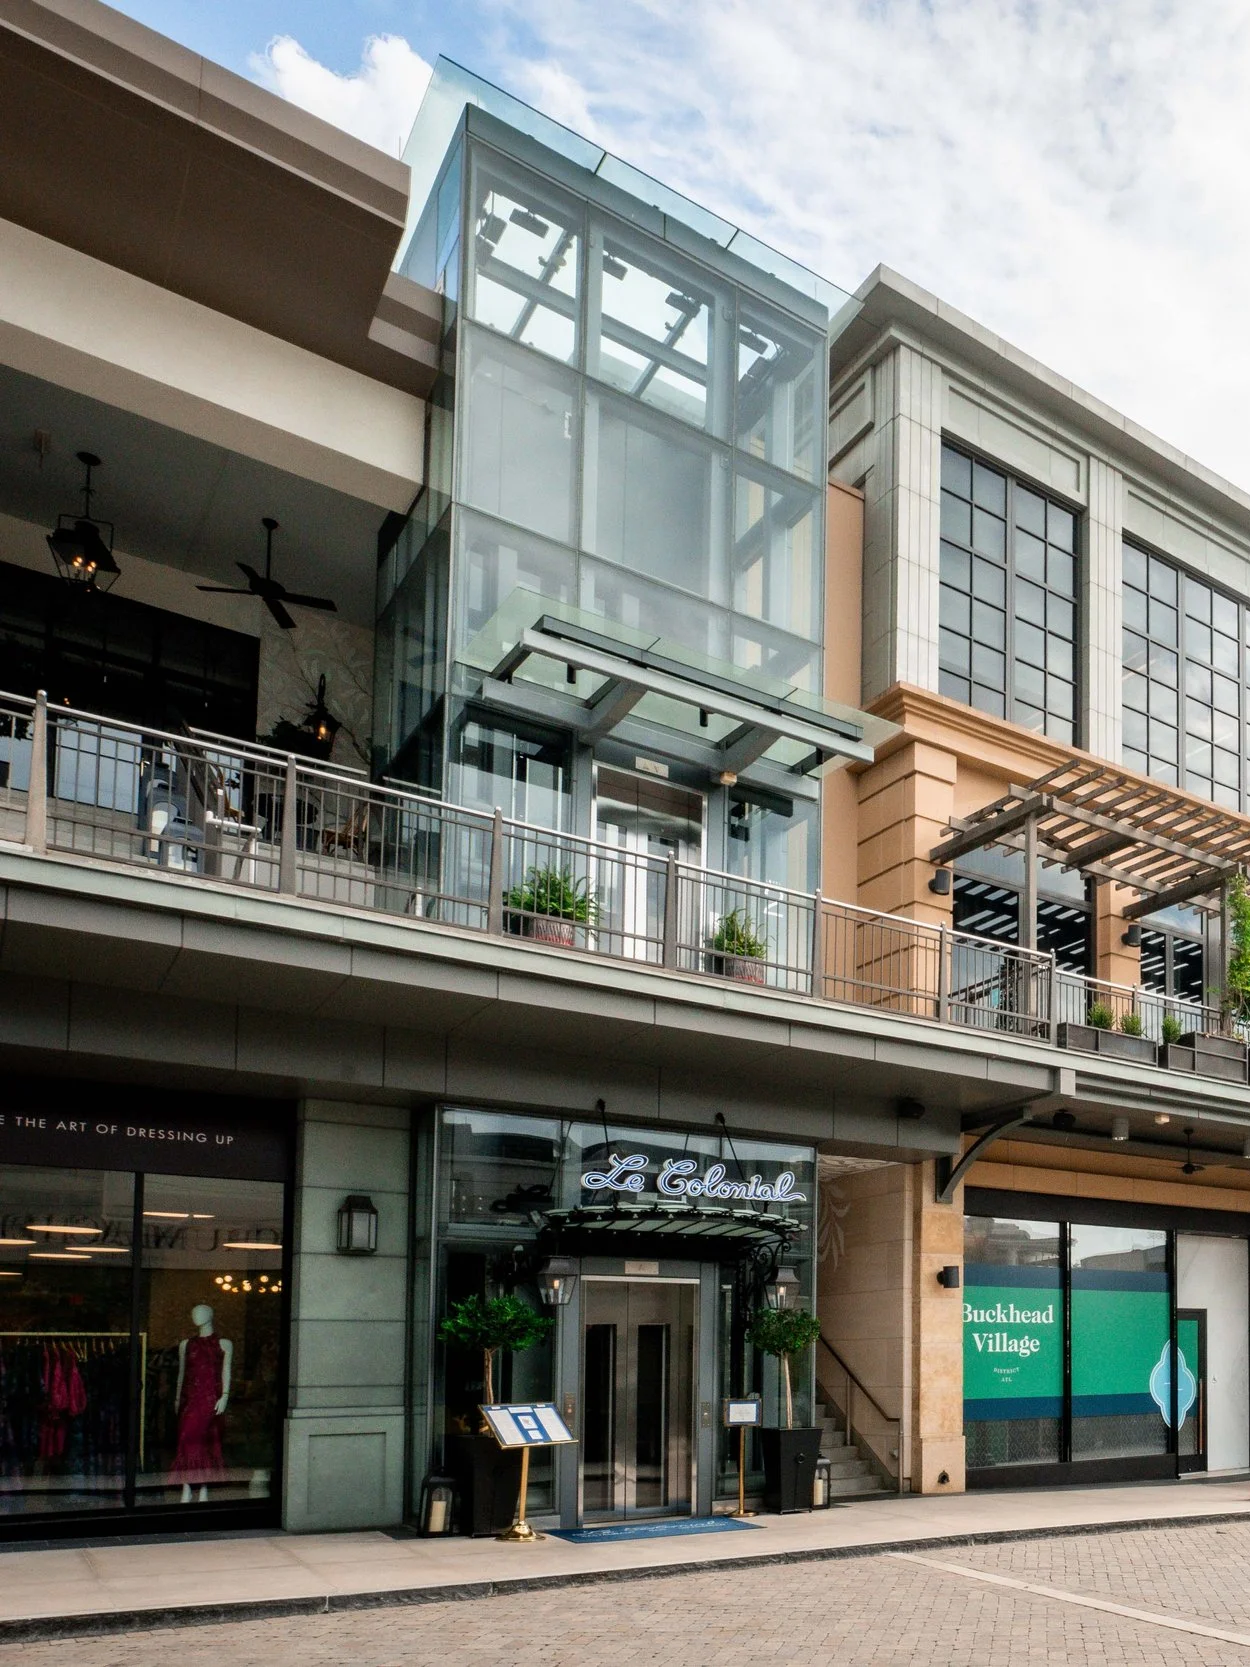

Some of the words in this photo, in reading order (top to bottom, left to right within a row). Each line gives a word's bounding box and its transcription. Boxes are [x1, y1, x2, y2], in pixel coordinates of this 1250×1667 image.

[15, 1116, 47, 1129] THE
[56, 1120, 87, 1132] ART
[95, 1123, 118, 1135] OF
[126, 1126, 207, 1143] DRESSING
[215, 1134, 234, 1145] UP
[581, 1153, 649, 1192] Le
[657, 1158, 807, 1202] Colonial
[962, 1303, 1055, 1324] Buckhead
[972, 1332, 1041, 1358] Village
[993, 1366, 1021, 1374] DISTRICT
